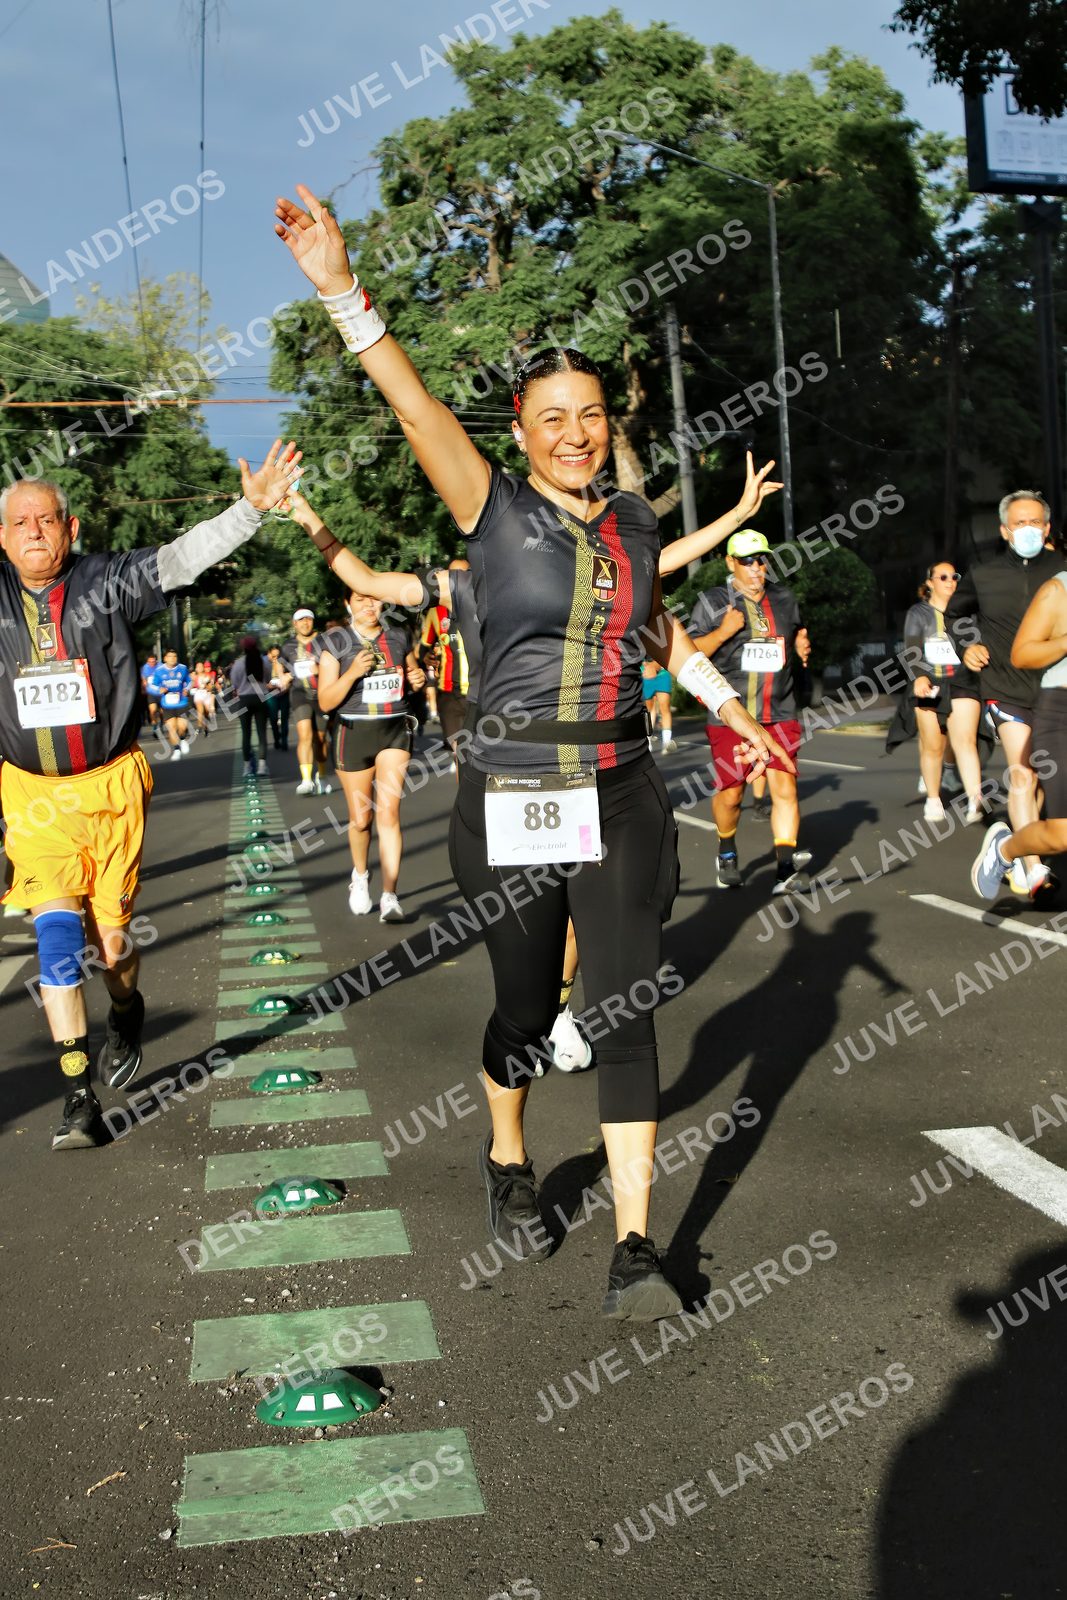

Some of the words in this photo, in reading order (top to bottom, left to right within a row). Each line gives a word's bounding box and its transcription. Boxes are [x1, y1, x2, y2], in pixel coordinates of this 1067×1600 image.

[747, 648, 778, 659] 11264
[367, 678, 399, 690] 11508
[19, 682, 82, 706] 12182
[524, 801, 561, 831] 88
